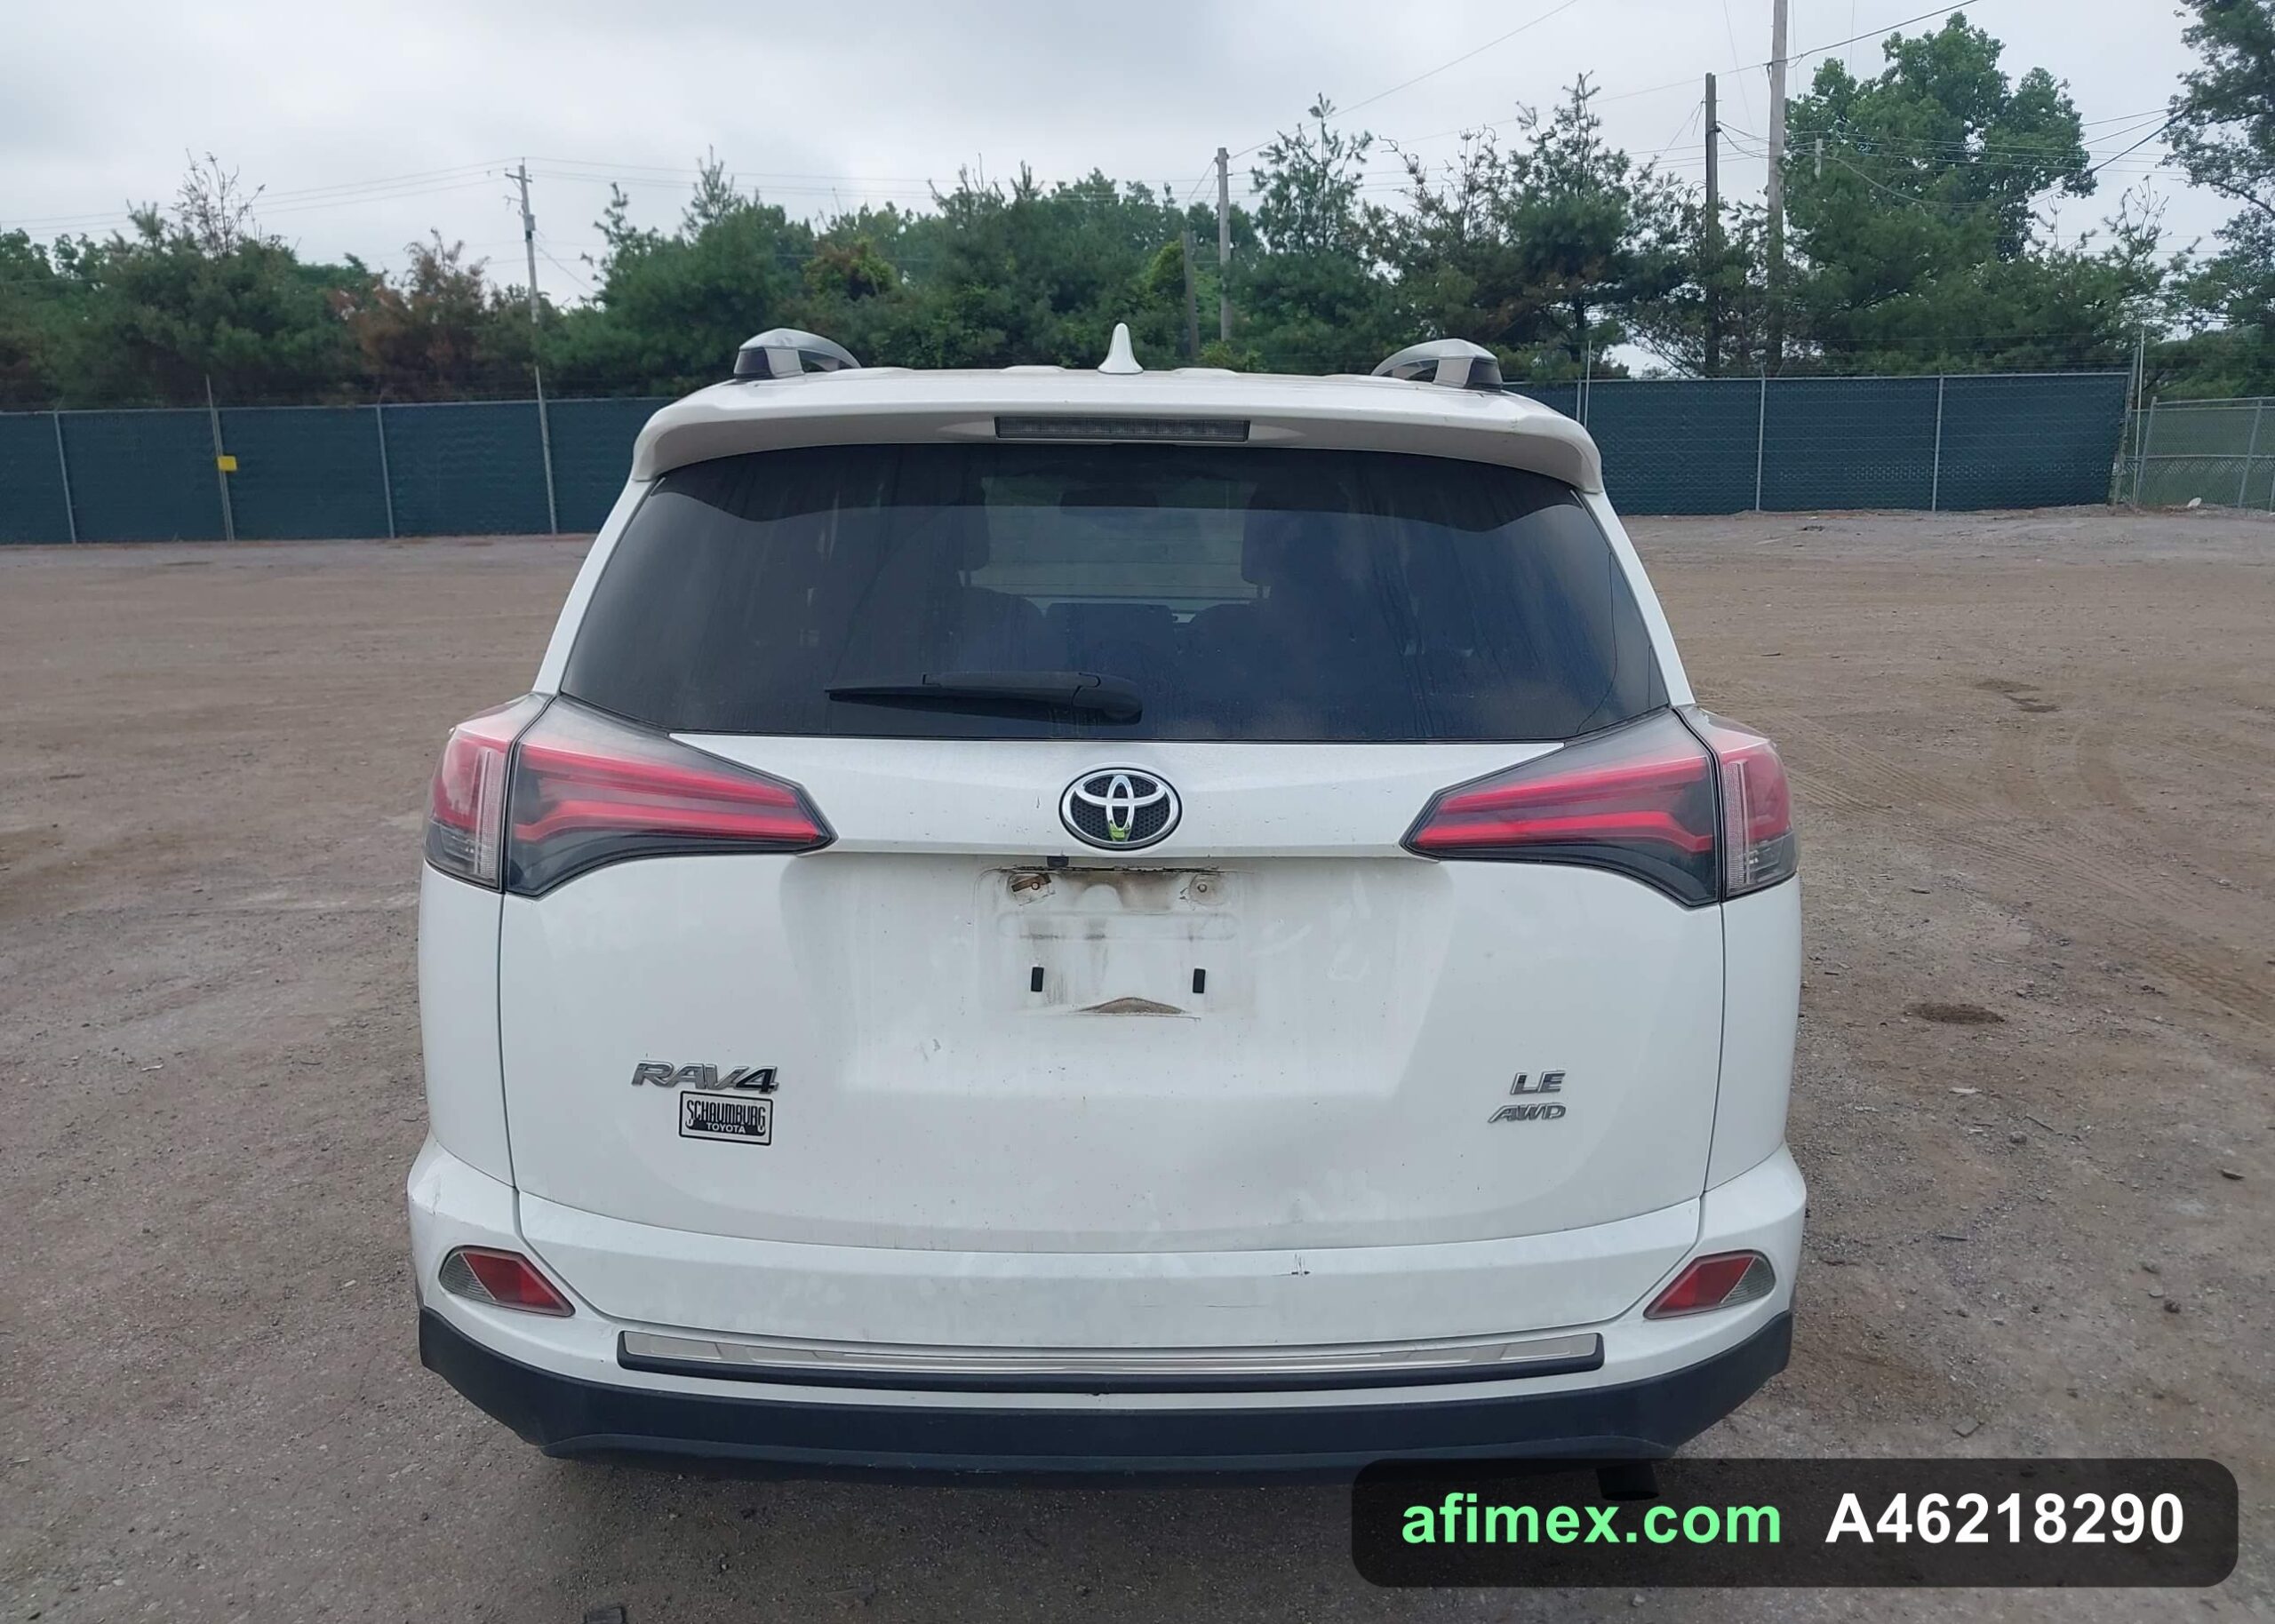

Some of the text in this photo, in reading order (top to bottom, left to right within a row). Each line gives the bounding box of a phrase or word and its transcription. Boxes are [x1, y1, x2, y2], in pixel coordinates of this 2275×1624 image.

[631, 1061, 779, 1095] RAV4
[1510, 1071, 1566, 1095] LE
[685, 1100, 767, 1127] SCHAUMBURG
[1488, 1103, 1567, 1123] AWD
[706, 1122, 747, 1134] TOYOTA
